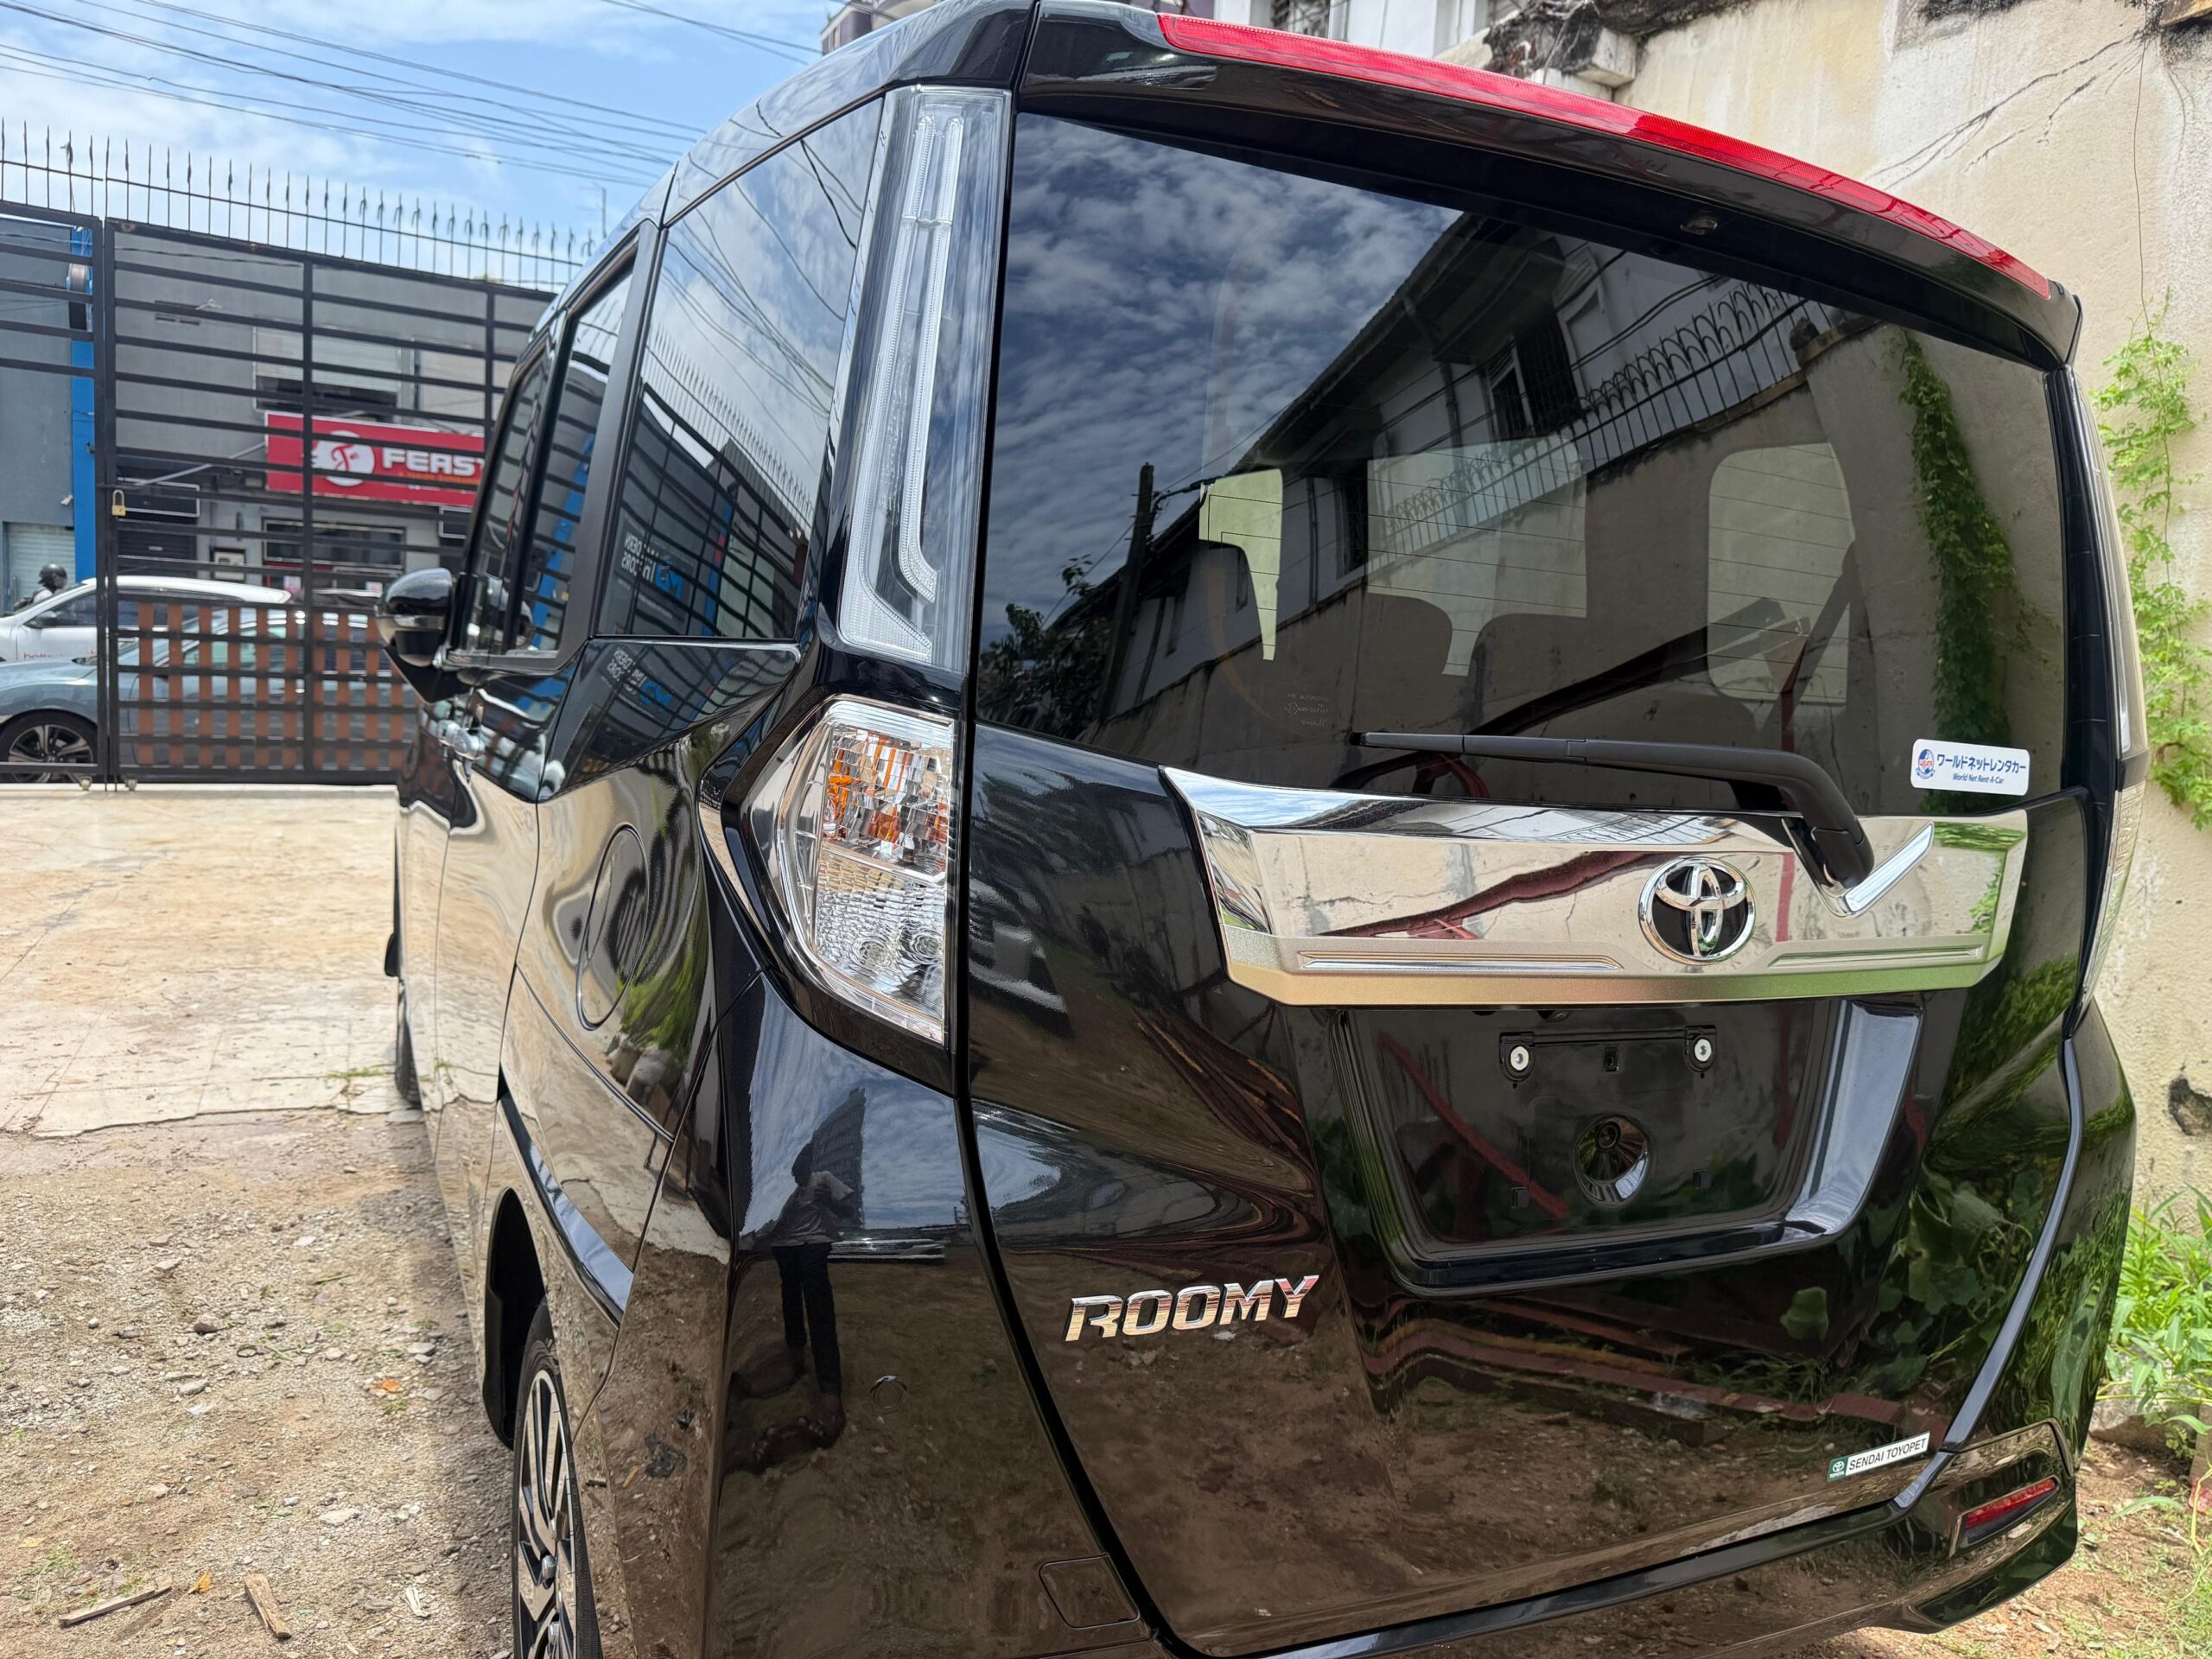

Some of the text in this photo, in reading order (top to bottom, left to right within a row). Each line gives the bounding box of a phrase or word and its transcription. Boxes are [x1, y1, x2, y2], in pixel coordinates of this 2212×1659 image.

[1936, 753, 2026, 773] ワールドネットレンタカー
[1953, 773, 1967, 782] World
[1978, 774, 2005, 784] Rent-A-Car
[1064, 1274, 1319, 1341] ROOMY
[1849, 1438, 1927, 1470] SENDAI TOYOPET
